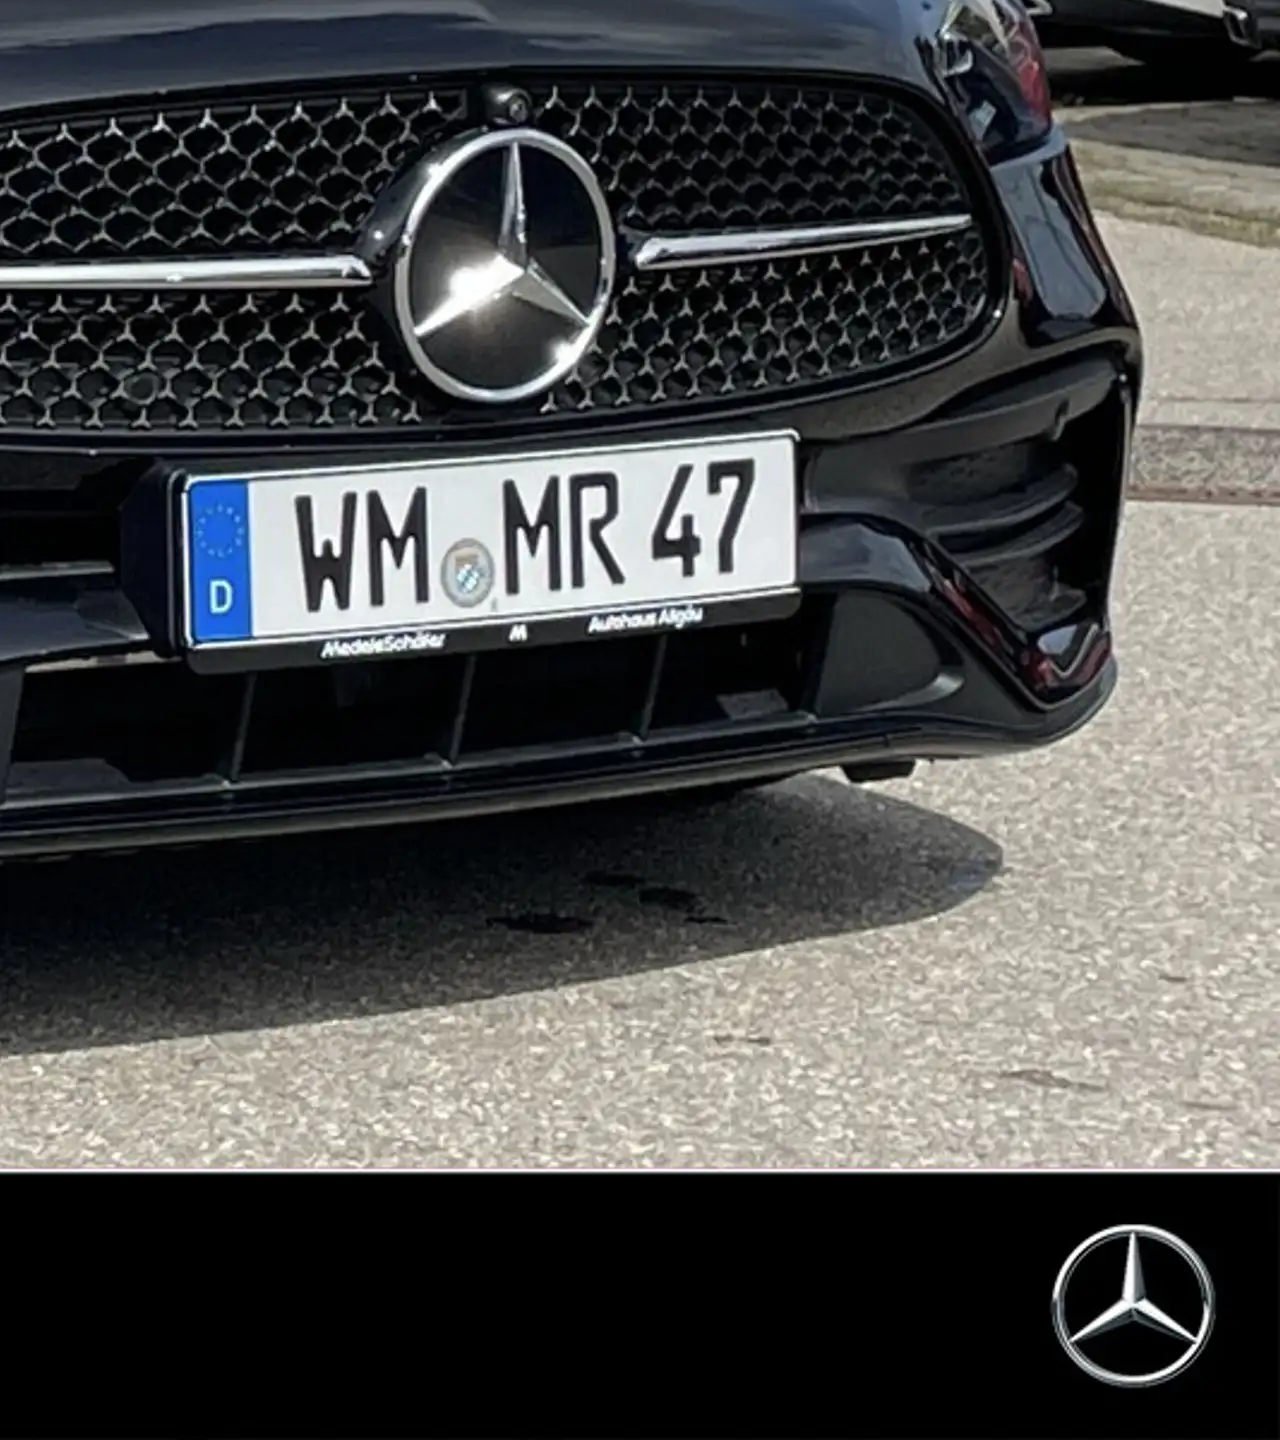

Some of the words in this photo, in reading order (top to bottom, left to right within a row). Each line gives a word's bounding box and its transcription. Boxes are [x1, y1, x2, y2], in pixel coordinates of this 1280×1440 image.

[295, 486, 429, 613] WM
[503, 472, 625, 596] MR
[651, 458, 756, 578] 47
[210, 578, 233, 614] D
[587, 610, 657, 634] Autohaus
[658, 605, 703, 630] Allgäu
